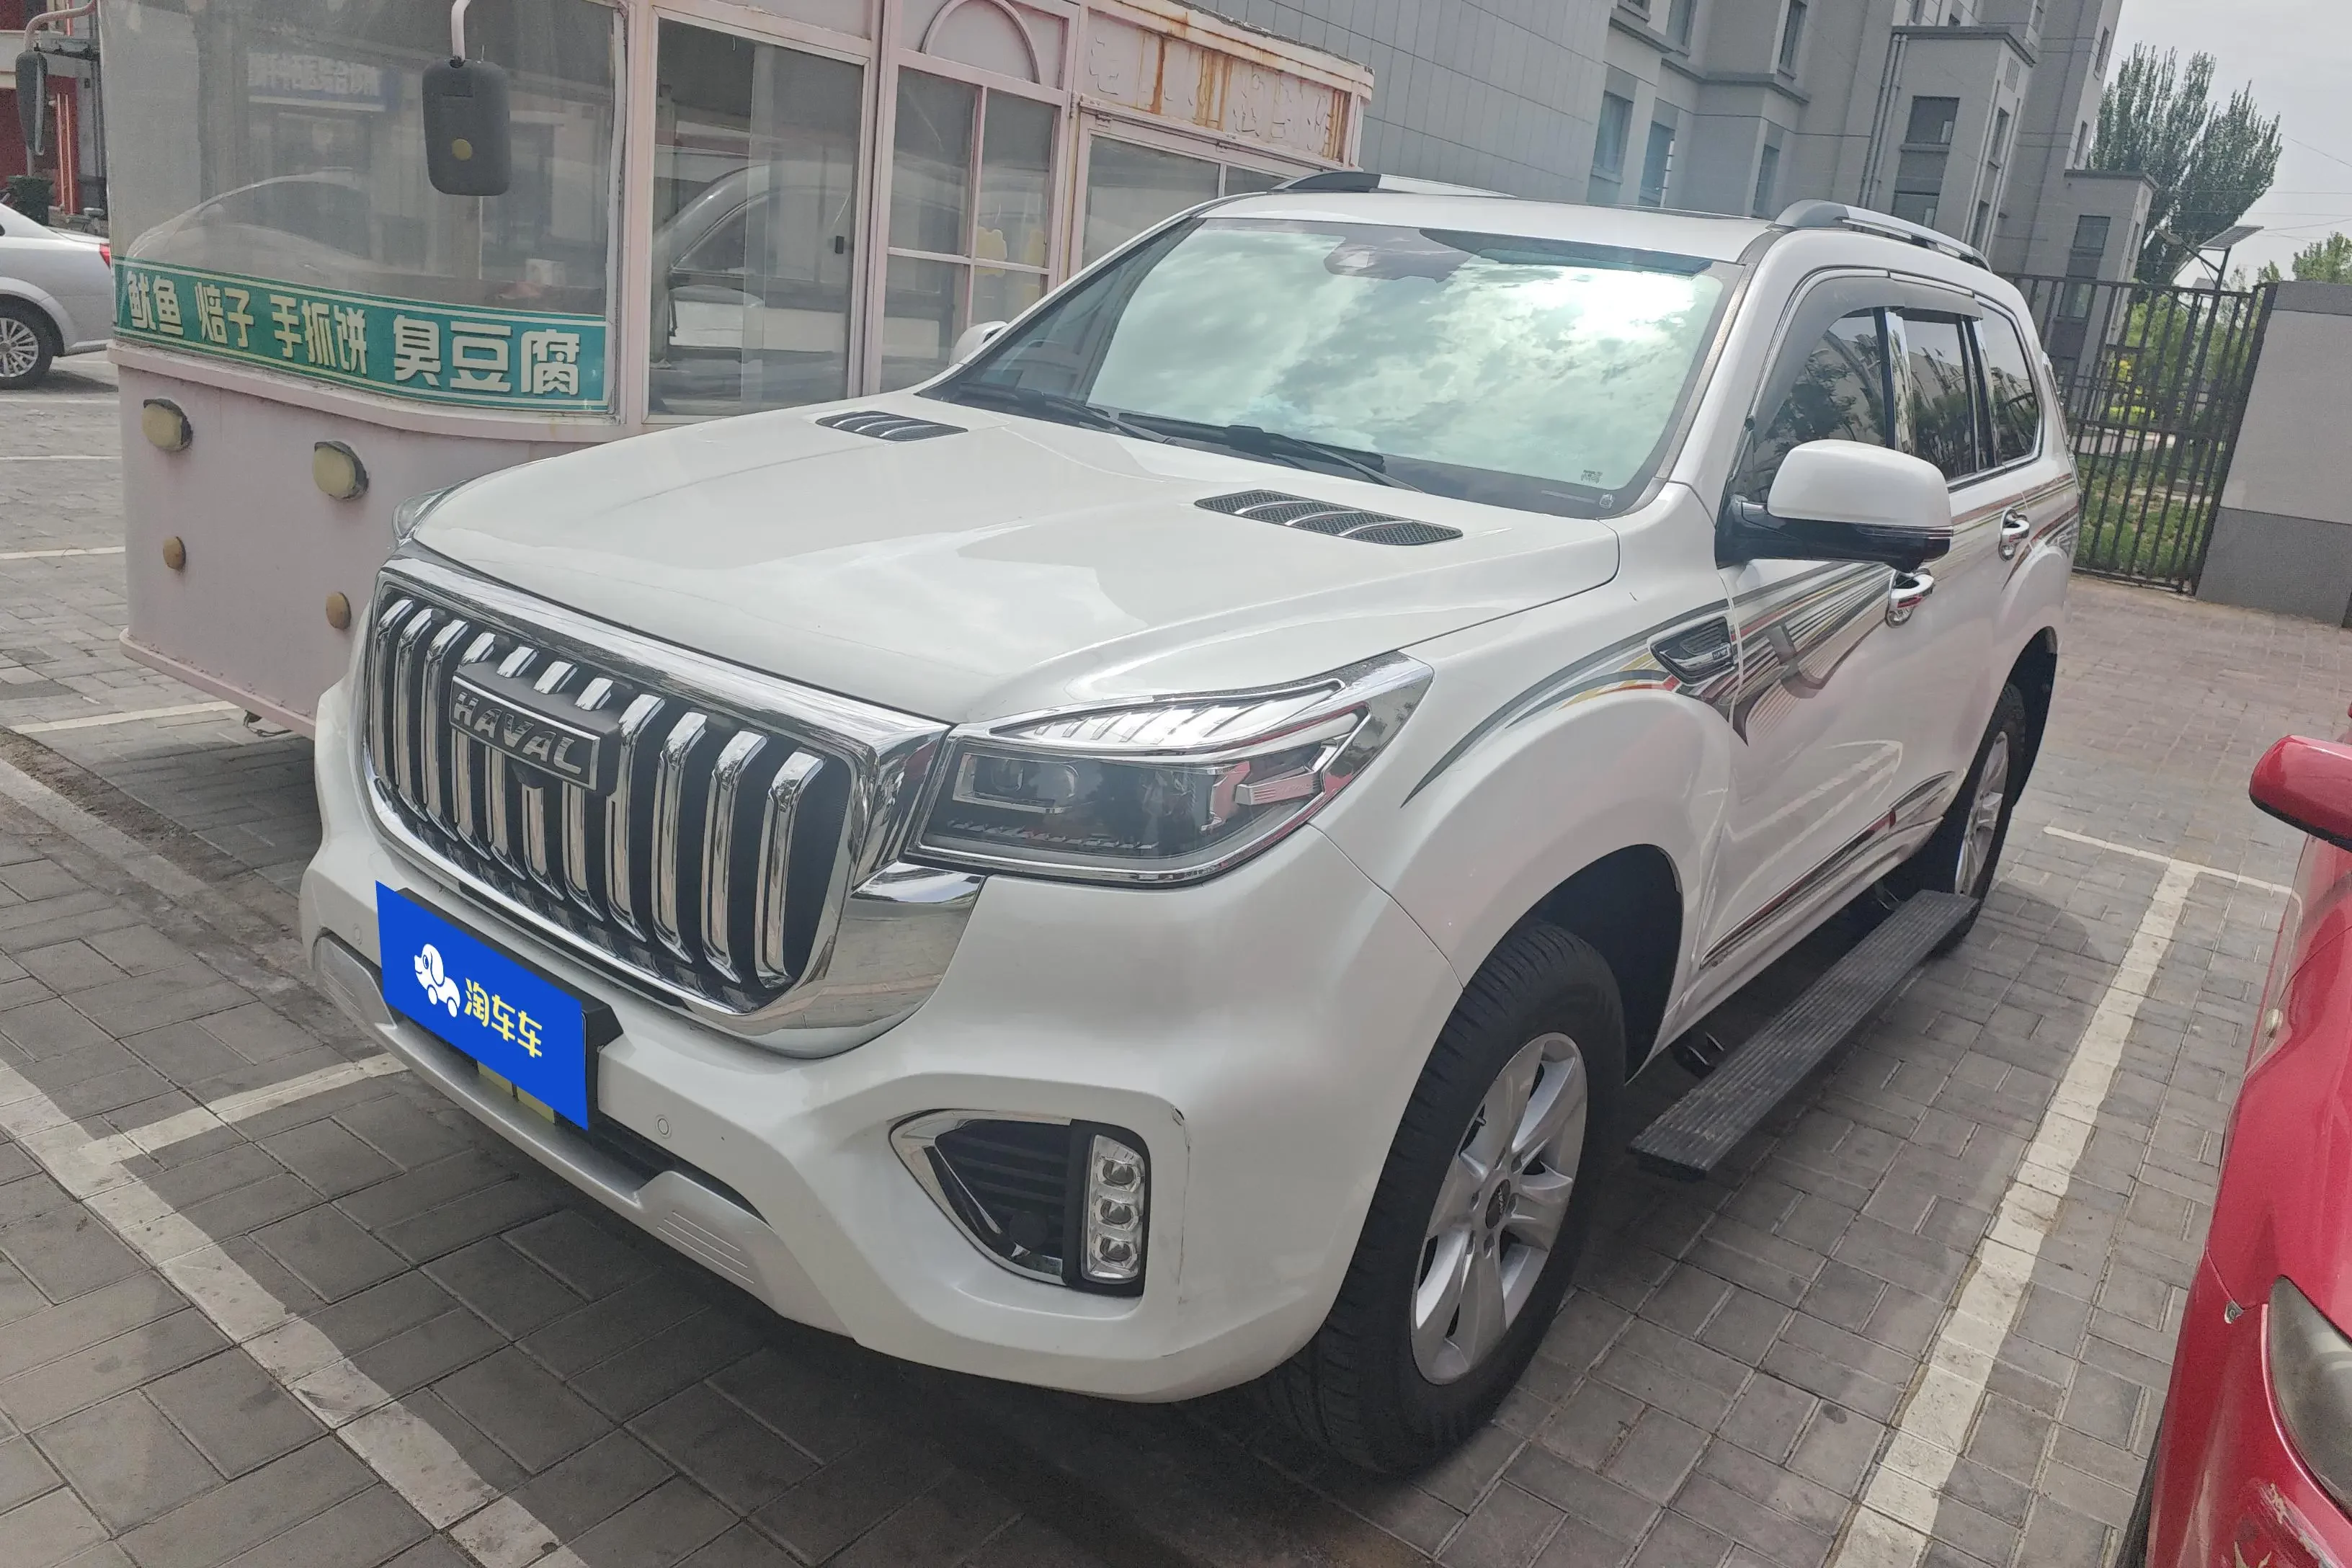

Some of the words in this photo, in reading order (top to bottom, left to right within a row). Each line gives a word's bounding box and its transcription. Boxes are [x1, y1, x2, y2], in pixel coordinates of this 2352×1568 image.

[127, 270, 184, 336] 鱿鱼
[195, 280, 254, 348] 焙子
[270, 294, 368, 375] 手抓饼
[393, 313, 581, 396] 臭豆腐
[453, 691, 582, 775] HAVAL
